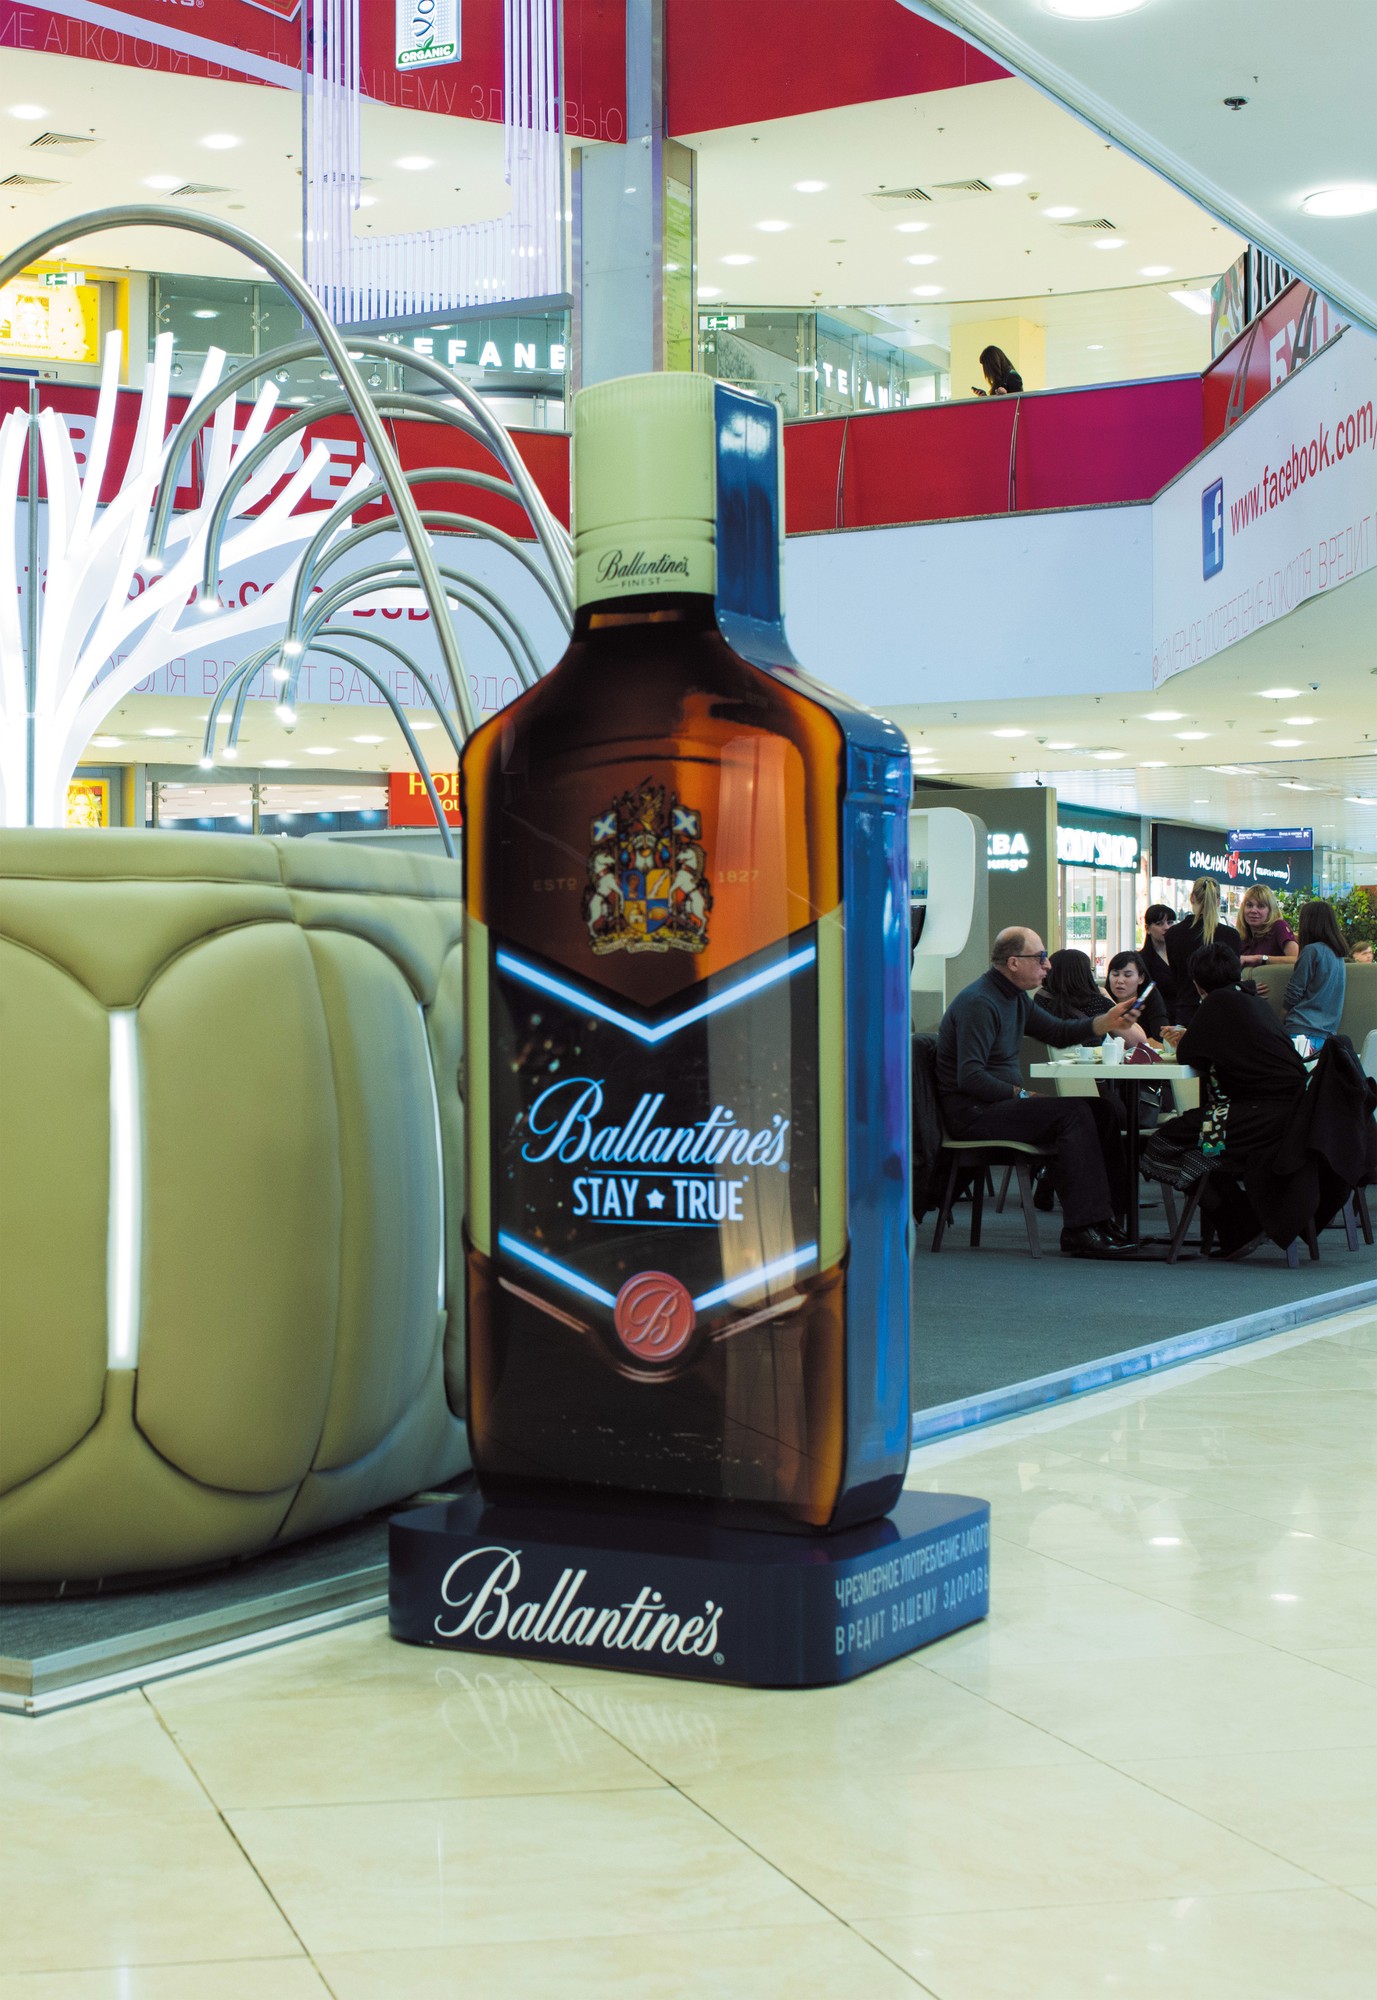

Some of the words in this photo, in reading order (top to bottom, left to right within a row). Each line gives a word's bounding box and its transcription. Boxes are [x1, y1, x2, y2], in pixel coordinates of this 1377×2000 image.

[401, 45, 452, 63] ORGANIC
[595, 549, 690, 584] Ballantine's
[1318, 516, 1371, 589] ВРЕДИТ
[621, 577, 661, 588] FINEST
[717, 869, 760, 884] 1827
[1237, 858, 1252, 877] КУБ
[521, 1076, 790, 1167] Ballantine's
[572, 1176, 640, 1218] STAY
[672, 1179, 745, 1221] TRUE
[624, 1287, 683, 1345] B
[835, 1556, 899, 1609] ЧРЕЗМЕРНОЕ
[899, 1534, 960, 1584] УПОТРЕБЛЕНИЕ
[433, 1545, 724, 1658] Ballantine's
[835, 1609, 886, 1656] ВРЕДИТ
[891, 1586, 938, 1633] ВАШЕМУ
